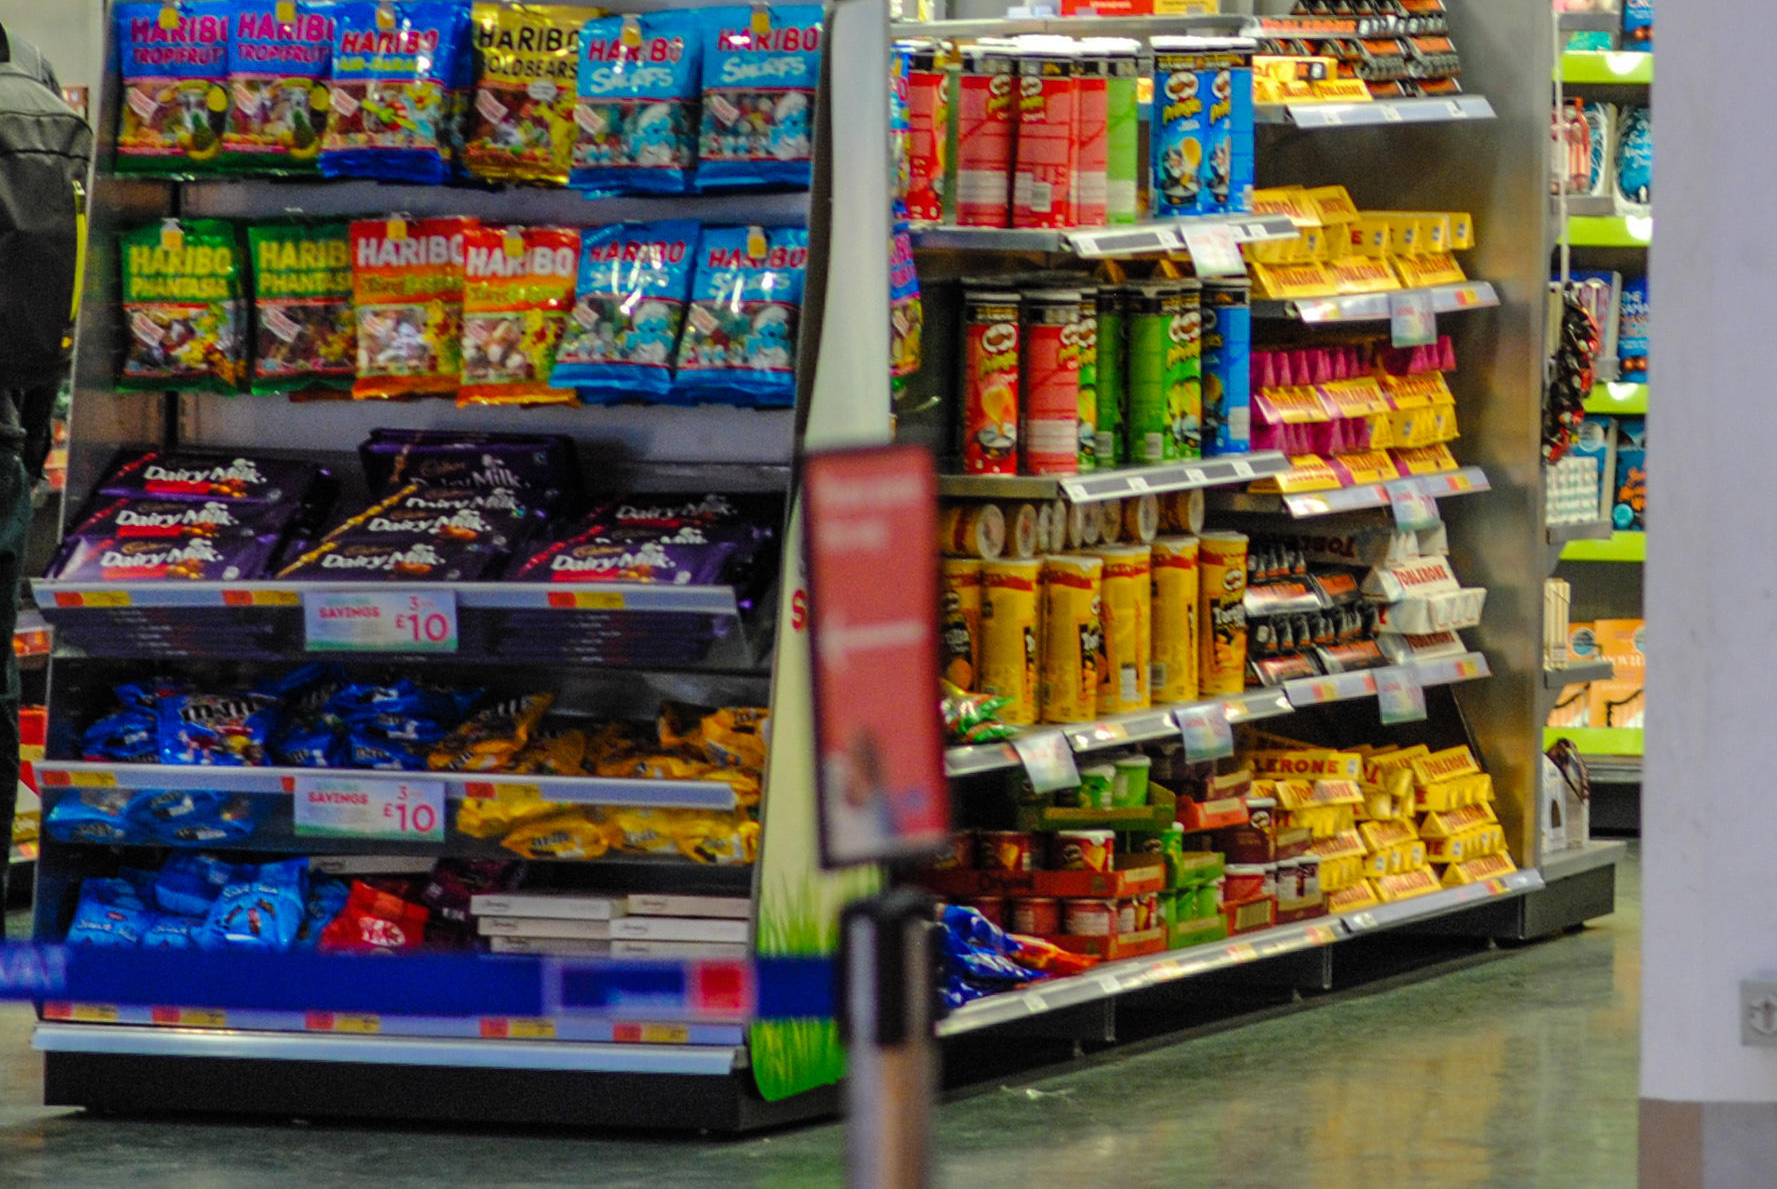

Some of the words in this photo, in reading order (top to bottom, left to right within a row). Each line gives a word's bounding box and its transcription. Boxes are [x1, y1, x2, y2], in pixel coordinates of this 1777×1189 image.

[341, 29, 439, 55] HARIBO
[477, 26, 579, 53] HARIBO
[588, 37, 684, 63] HARBO
[717, 26, 819, 52] HARIBO
[357, 234, 464, 267] HARIBO
[466, 246, 576, 277] HARIBO
[708, 247, 807, 270] HARBO
[319, 606, 380, 619] SAVINGS
[395, 613, 448, 642] £10
[307, 791, 369, 805] SAVINGS
[382, 803, 437, 833] £10
